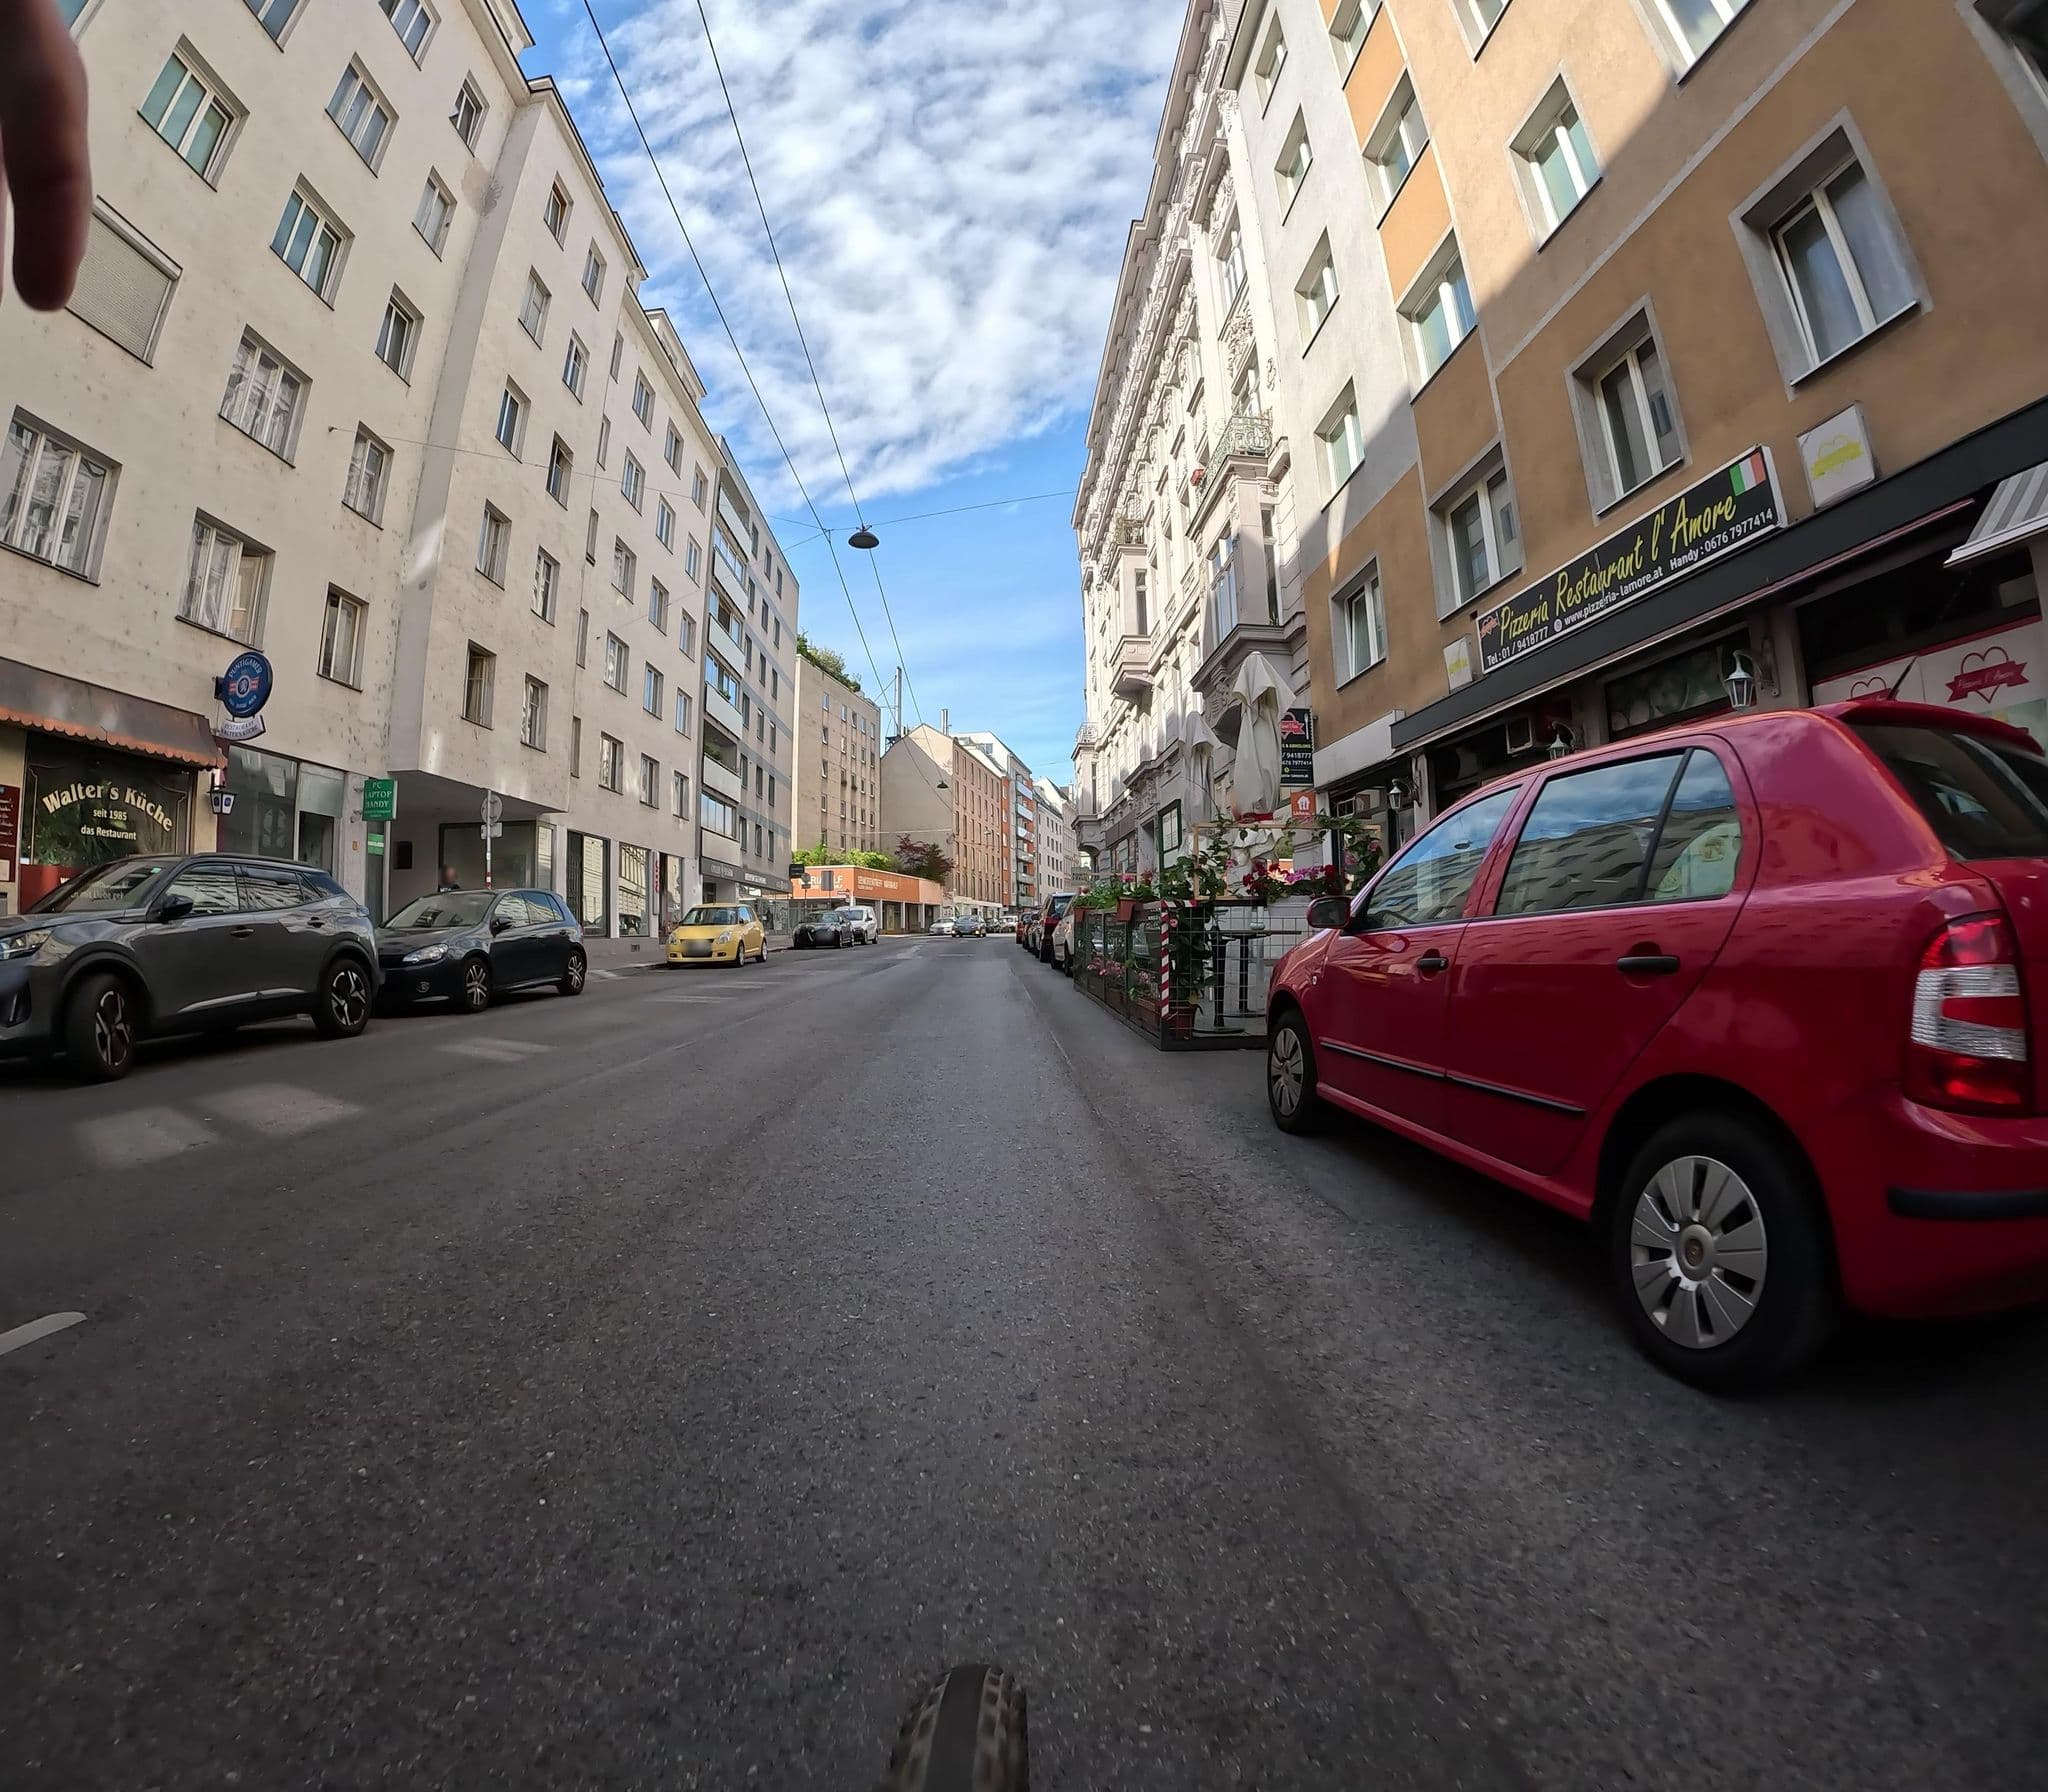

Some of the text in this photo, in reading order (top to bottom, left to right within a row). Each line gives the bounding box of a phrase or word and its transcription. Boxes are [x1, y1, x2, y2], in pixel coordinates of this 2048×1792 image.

[1500, 595, 1550, 646] Pizzeria
[1556, 535, 1644, 617] Restaurant
[1517, 626, 1549, 651] 9418777
[1704, 531, 1728, 552] 0676
[1729, 508, 1773, 539] 7977414
[372, 781, 383, 789] PC
[93, 808, 128, 821] seit 1985
[124, 787, 173, 832] Küche
[80, 825, 137, 841] das Restaurant
